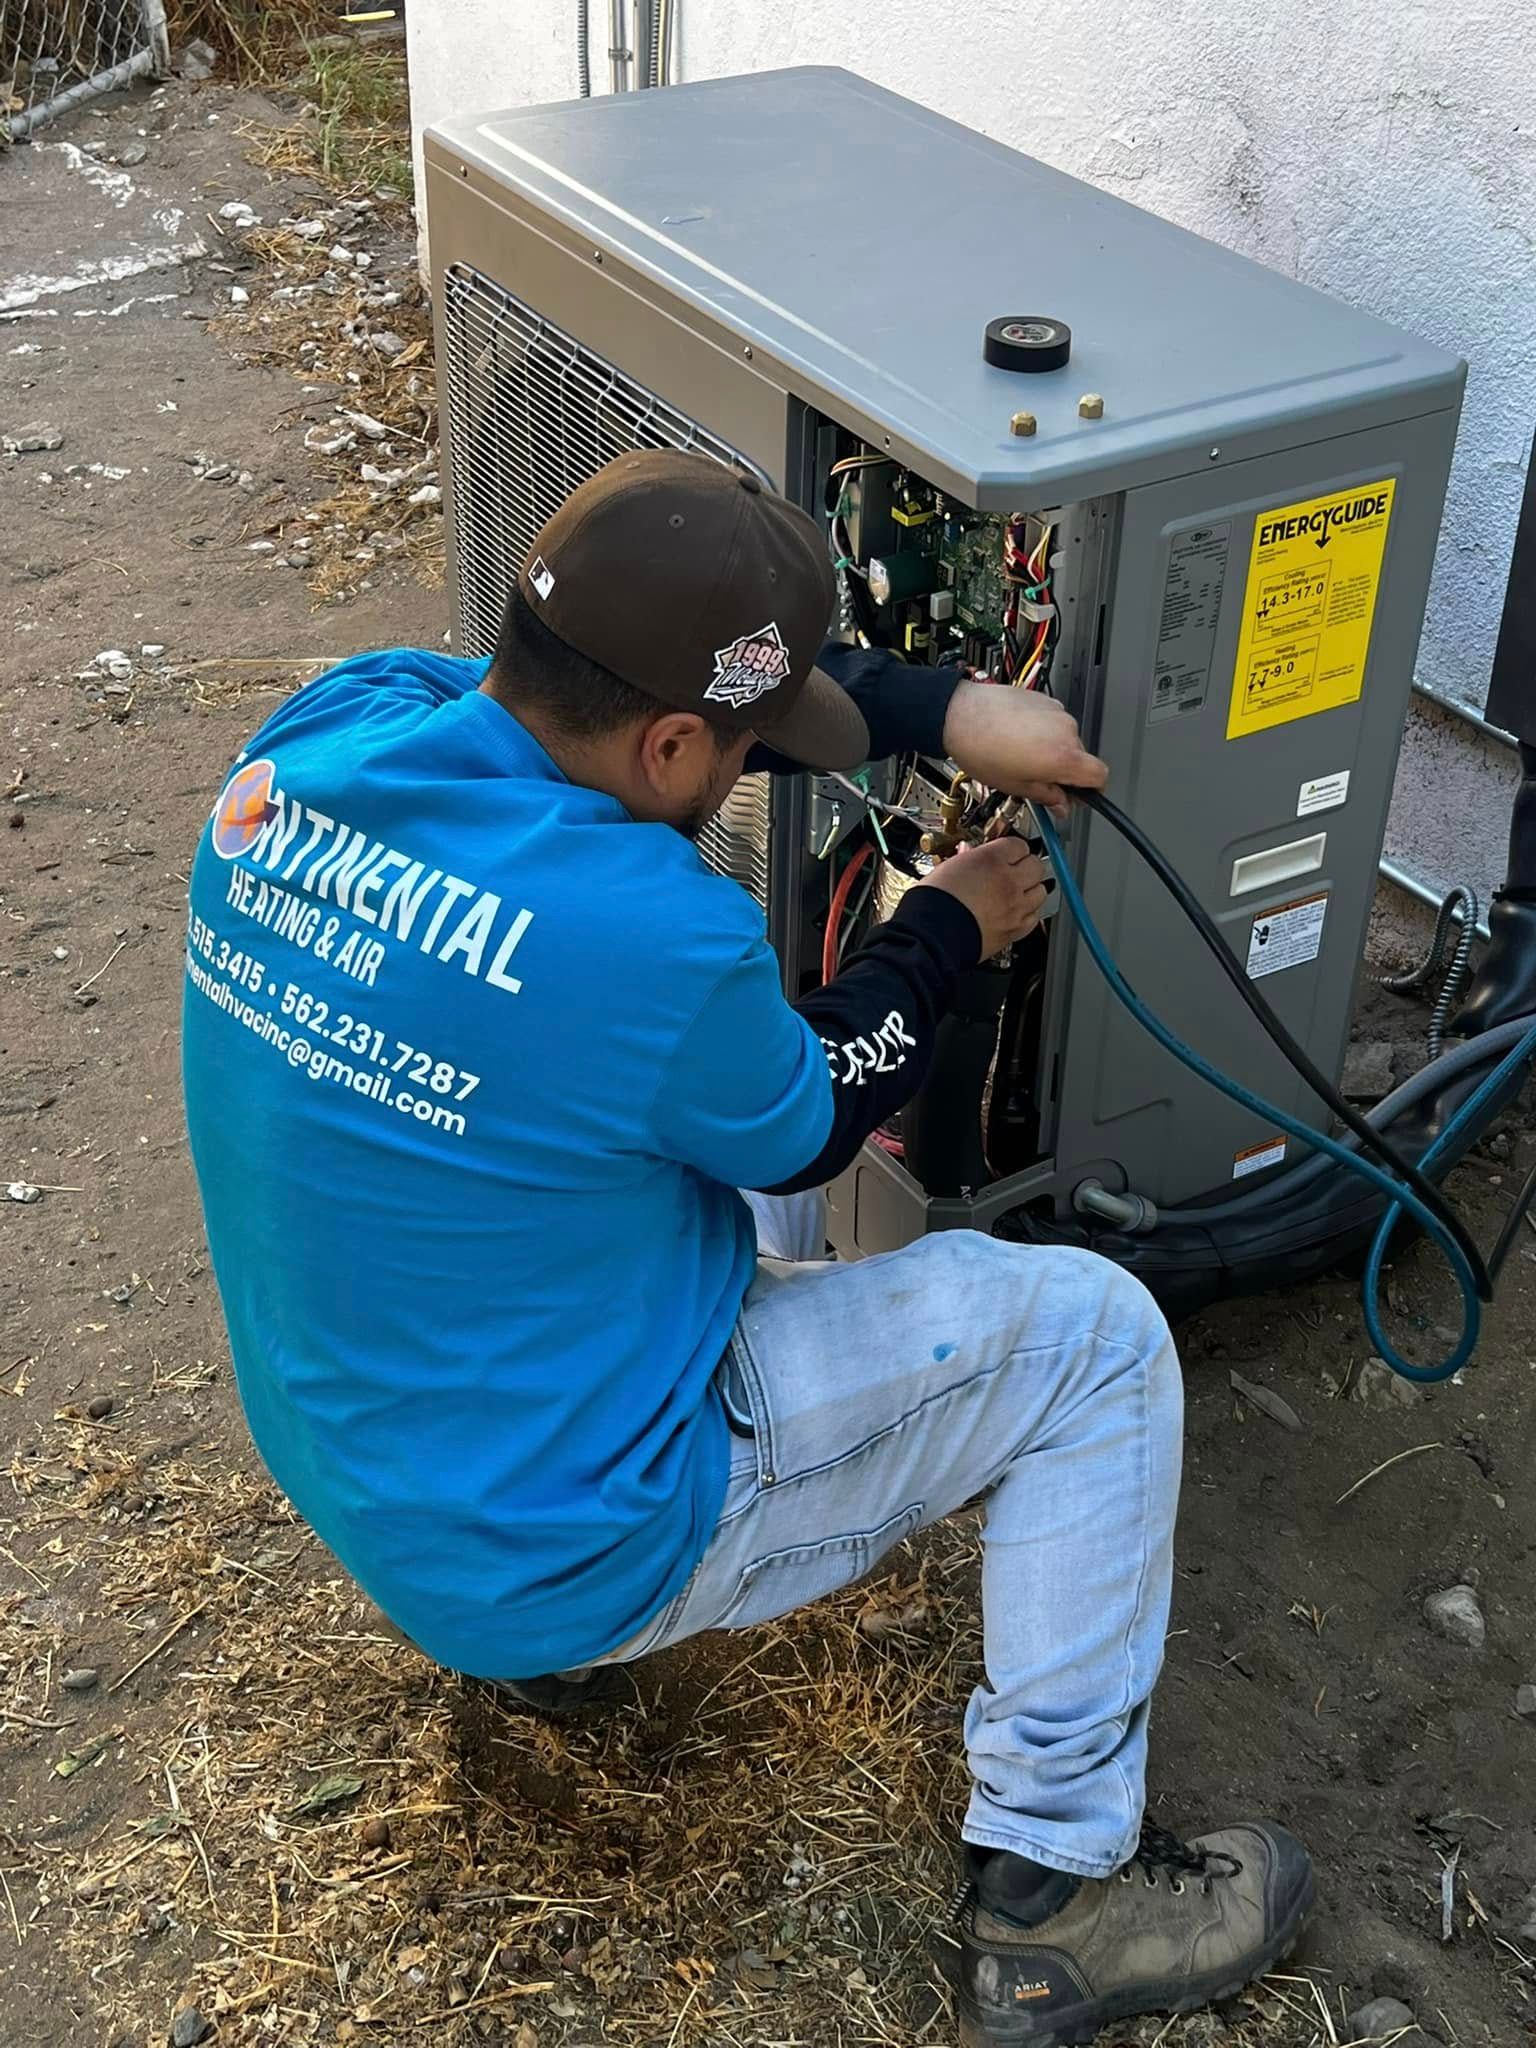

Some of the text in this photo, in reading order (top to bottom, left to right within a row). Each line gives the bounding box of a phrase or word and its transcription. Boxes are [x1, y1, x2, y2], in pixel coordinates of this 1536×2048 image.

[1259, 493, 1388, 549] ENERGYGUIDE
[1261, 581, 1324, 611] 14.3-17.0
[225, 863, 386, 988] HEATING & AIR
[281, 981, 481, 1102] 562.231.7287
[1014, 1980, 1049, 1993] ARIAT
